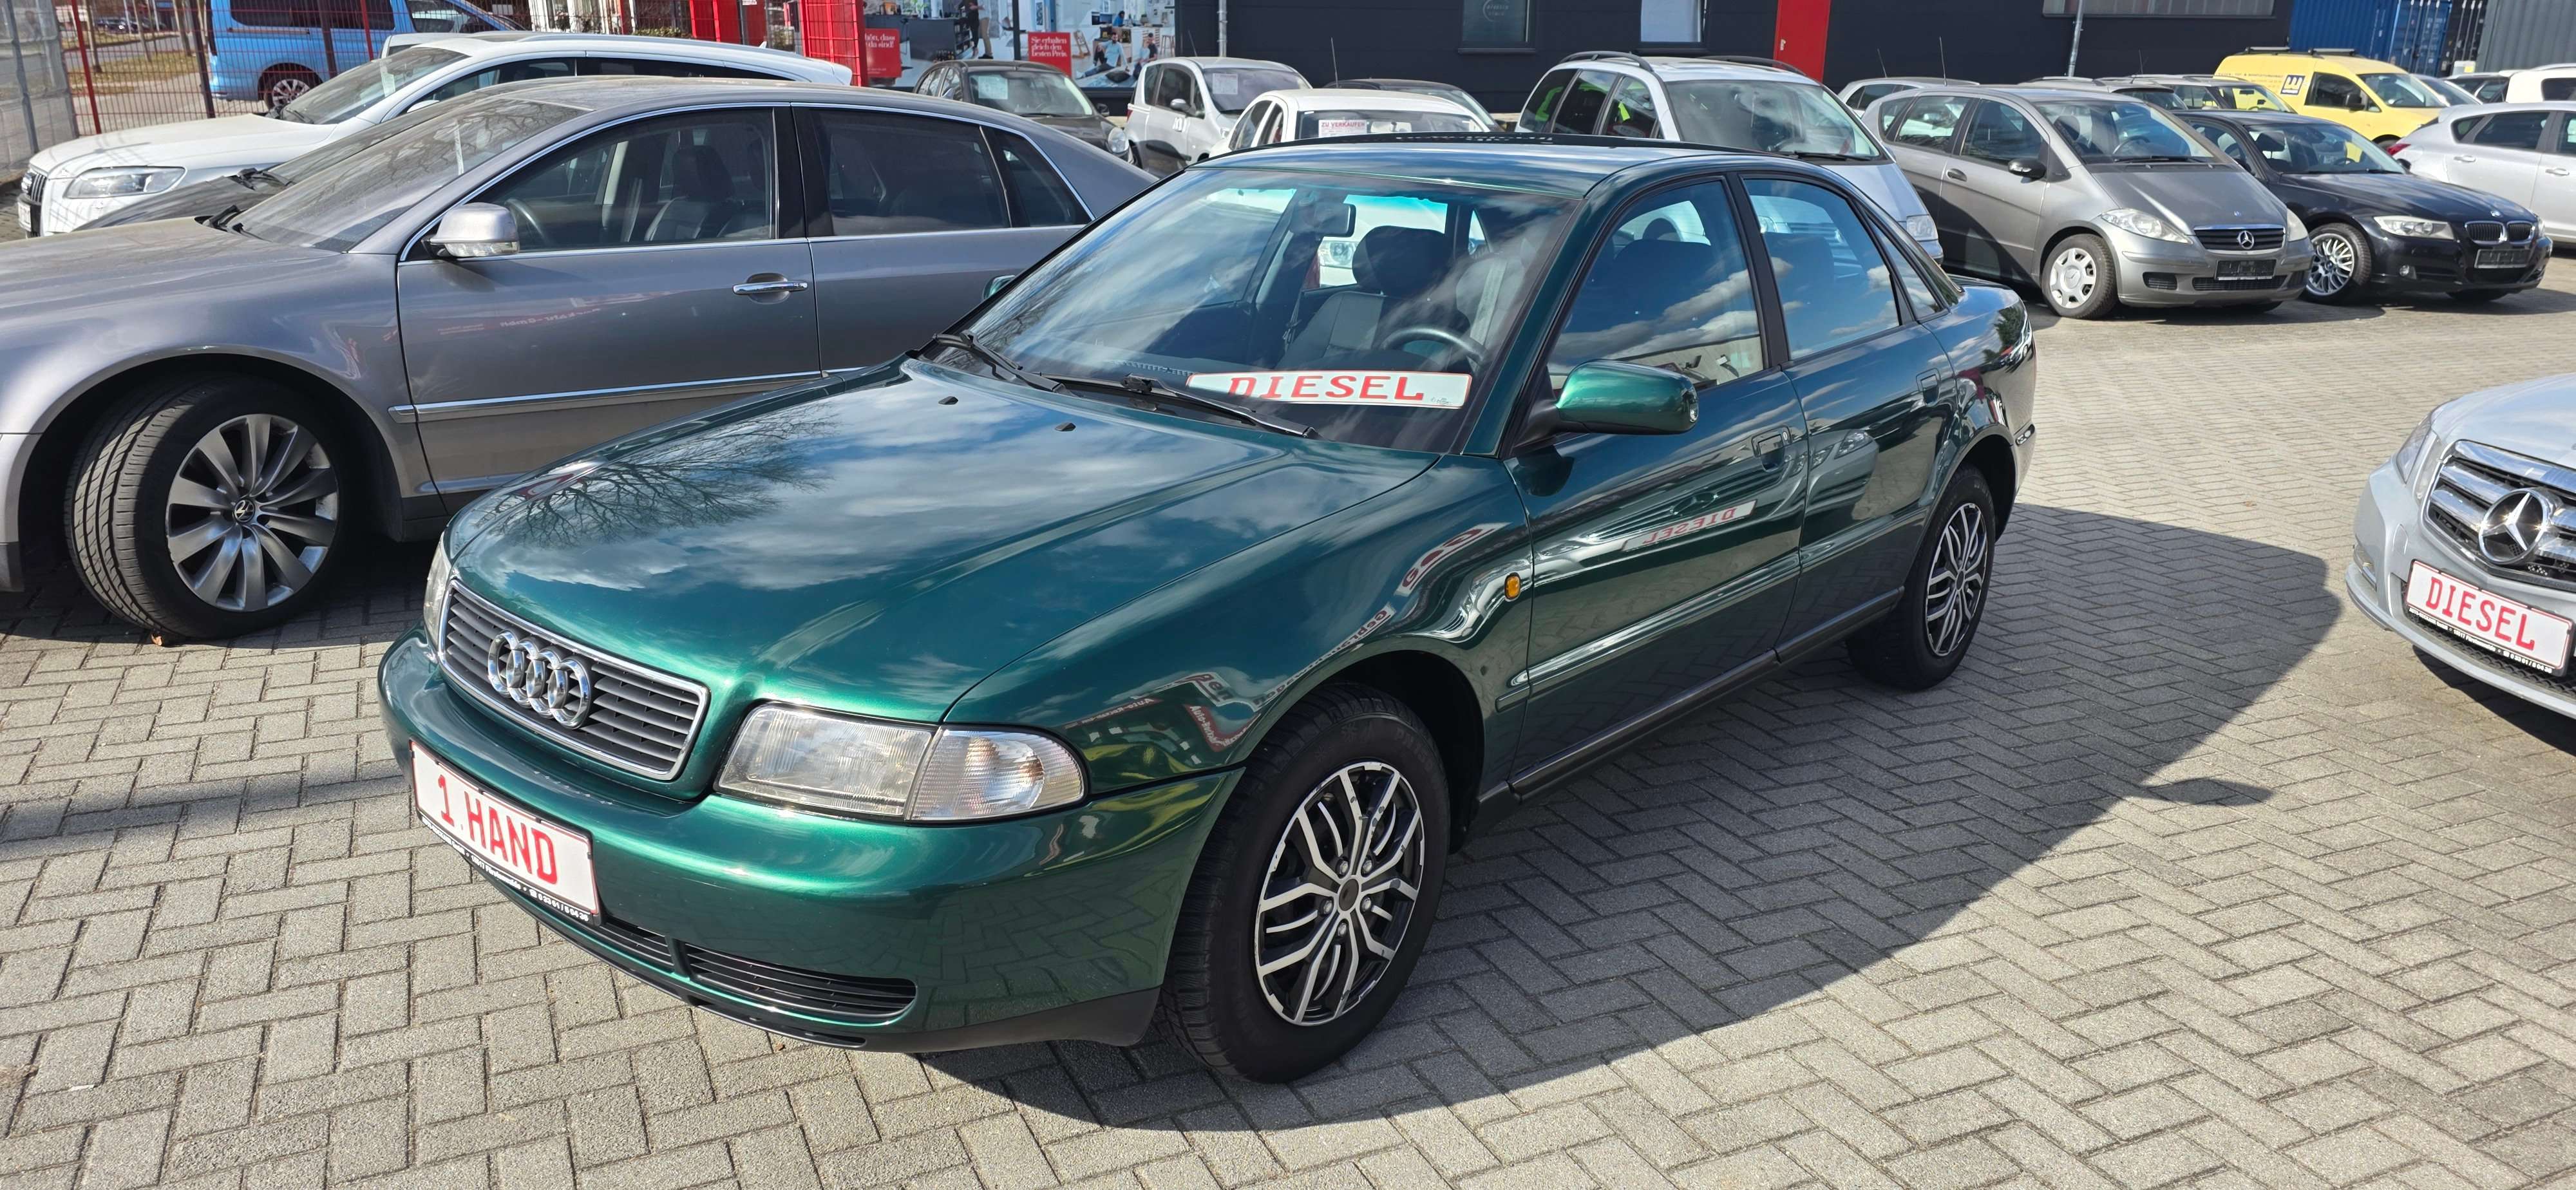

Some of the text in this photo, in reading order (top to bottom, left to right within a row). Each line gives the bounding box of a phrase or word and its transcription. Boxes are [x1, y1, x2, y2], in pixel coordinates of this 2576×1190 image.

[1228, 375, 1424, 401] DIESEL
[2425, 577, 2535, 650] DIESEL
[438, 775, 558, 885] 1 HAND
